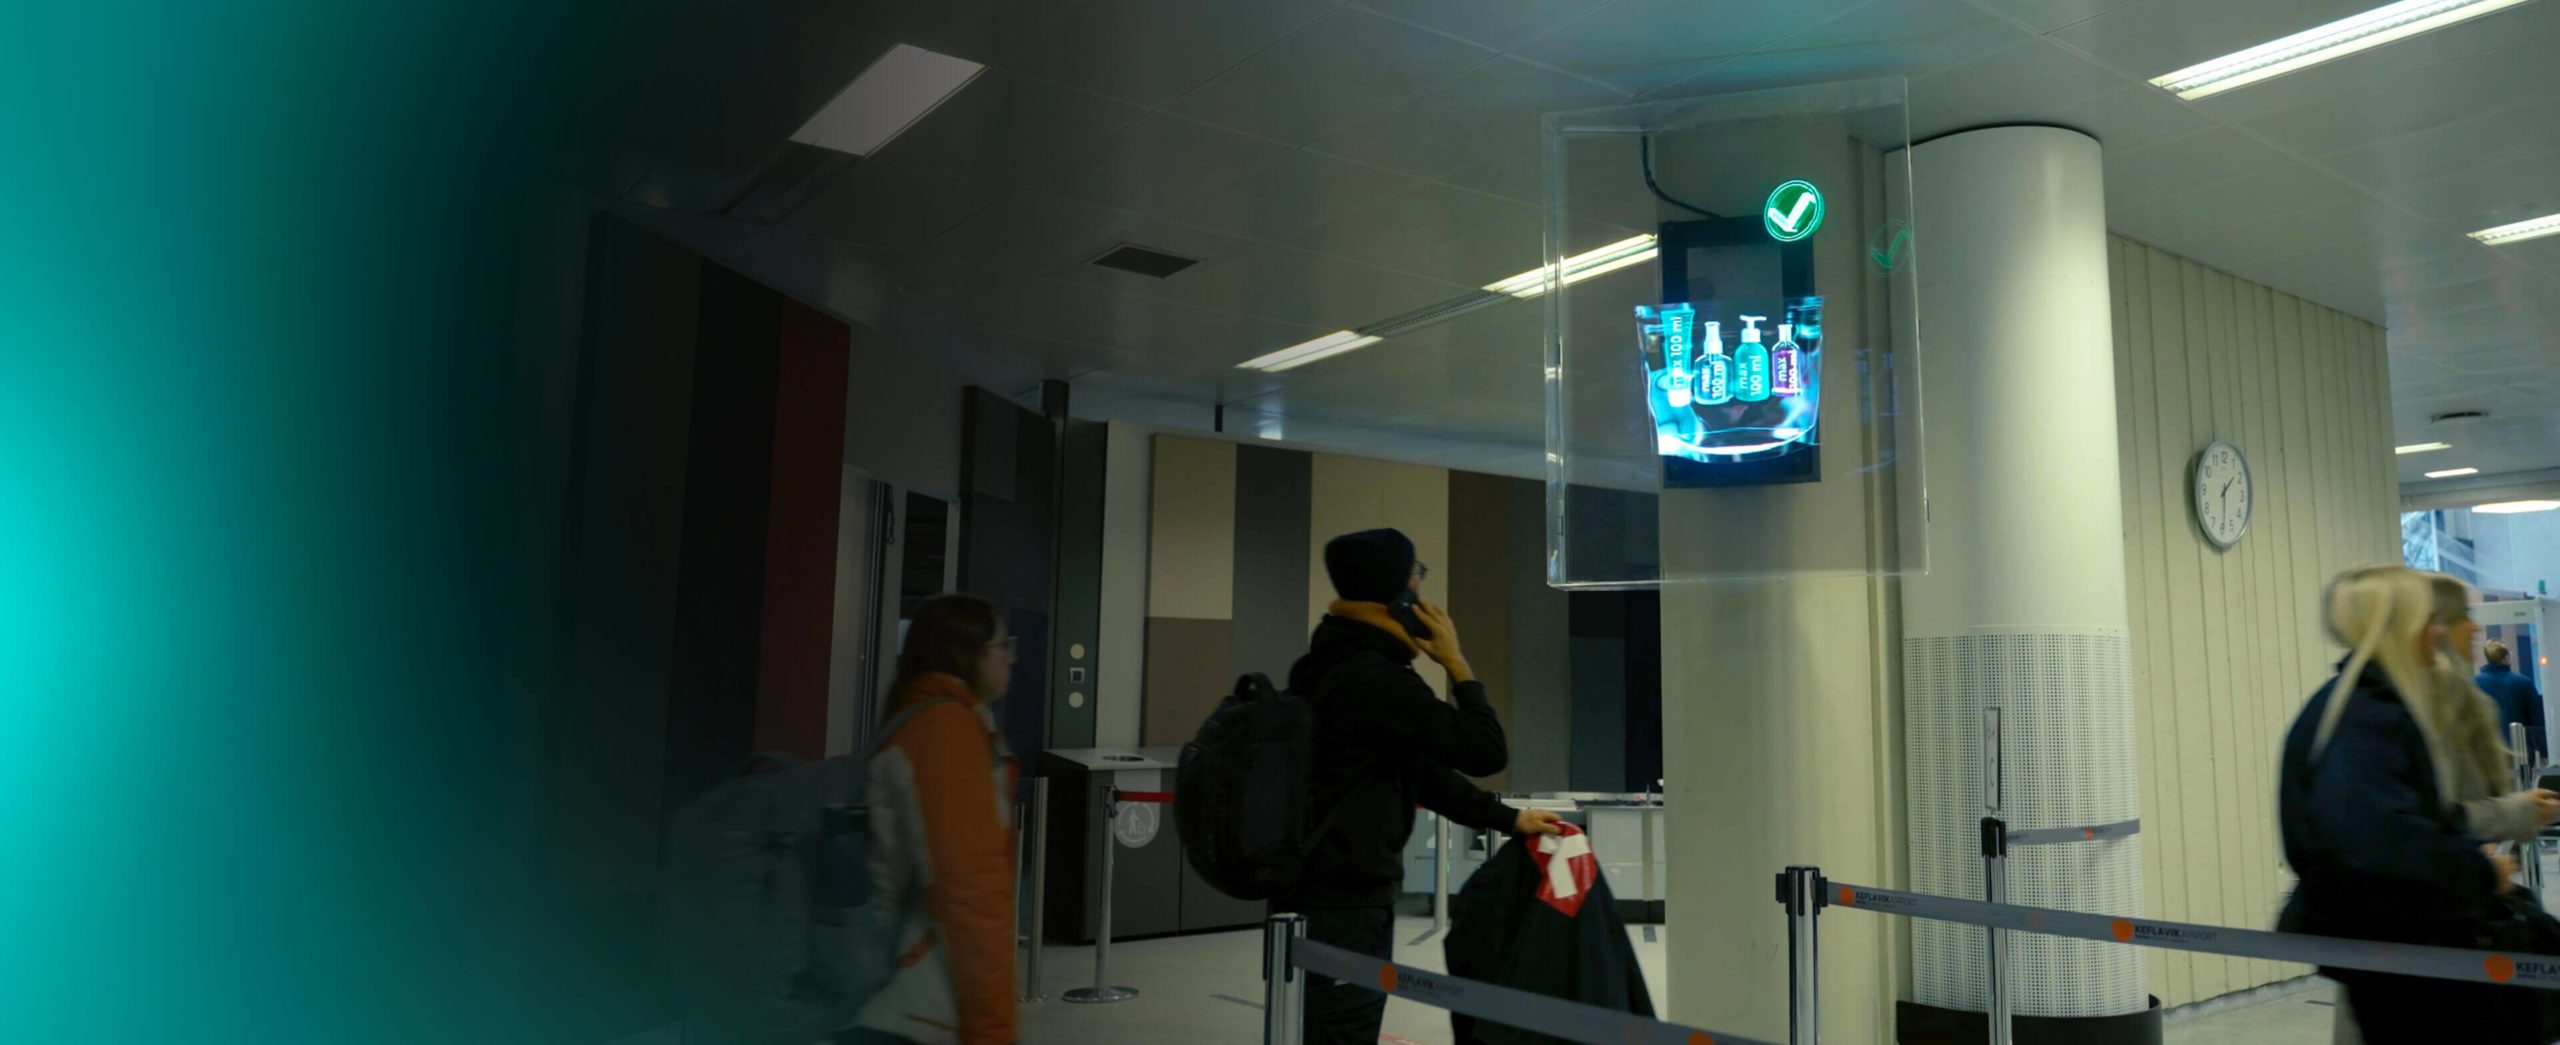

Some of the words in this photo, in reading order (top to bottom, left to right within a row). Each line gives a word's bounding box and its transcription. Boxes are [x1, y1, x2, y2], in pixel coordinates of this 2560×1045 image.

[1670, 315, 1683, 333] ml
[1670, 335, 1683, 357] 100
[1672, 360, 1683, 388] max
[1748, 354, 1763, 372] ml
[1777, 356, 1788, 382] max
[1739, 363, 1748, 390] max
[1750, 374, 1763, 397] 100
[1712, 377, 1723, 399] 100
[2220, 451, 2229, 464] 12
[2135, 925, 2180, 938] KEFLAVIK
[2516, 961, 2560, 975] KEFLA
